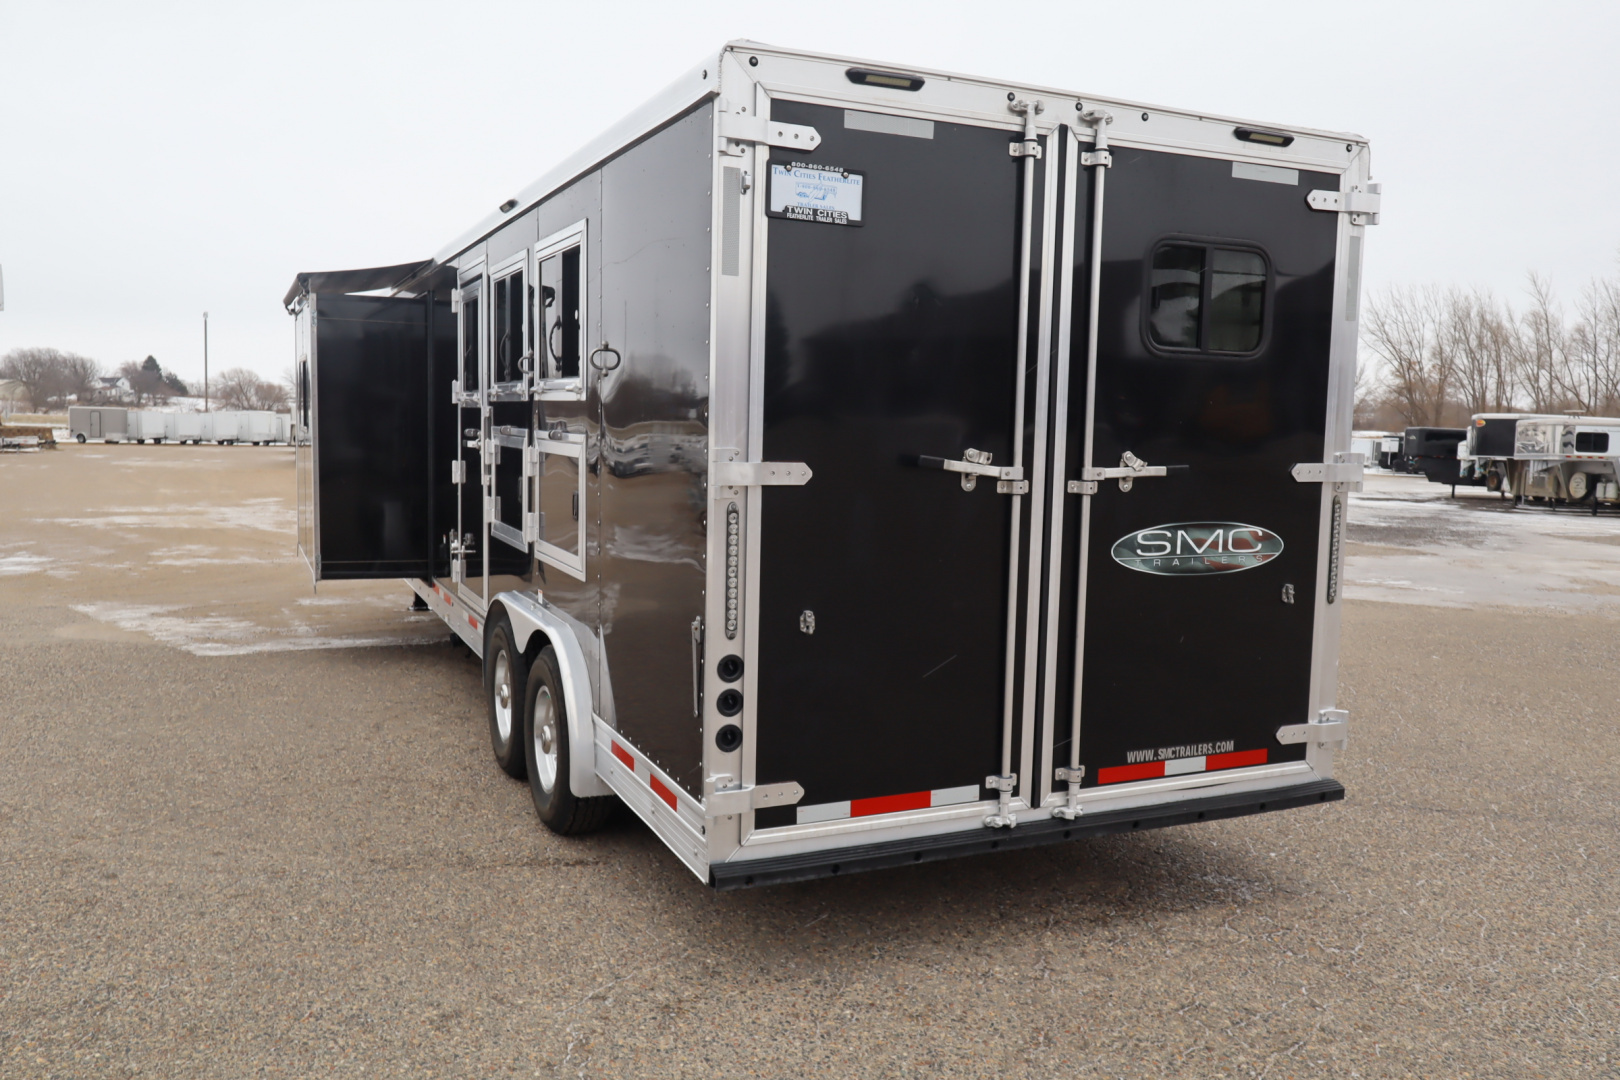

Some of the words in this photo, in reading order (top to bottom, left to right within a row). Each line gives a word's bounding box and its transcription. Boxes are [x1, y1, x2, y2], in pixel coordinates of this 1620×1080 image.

[791, 162, 843, 172] 800-860-6548
[786, 205, 813, 215] TWIN
[817, 209, 847, 219] CITIES
[786, 212, 814, 221] FEATHERLITE
[815, 215, 832, 223] TRAILER
[1136, 528, 1263, 557] SMC
[1134, 555, 1263, 566] TRAILERS
[1127, 740, 1234, 764] WWW.SMCTRAILERS.COM
